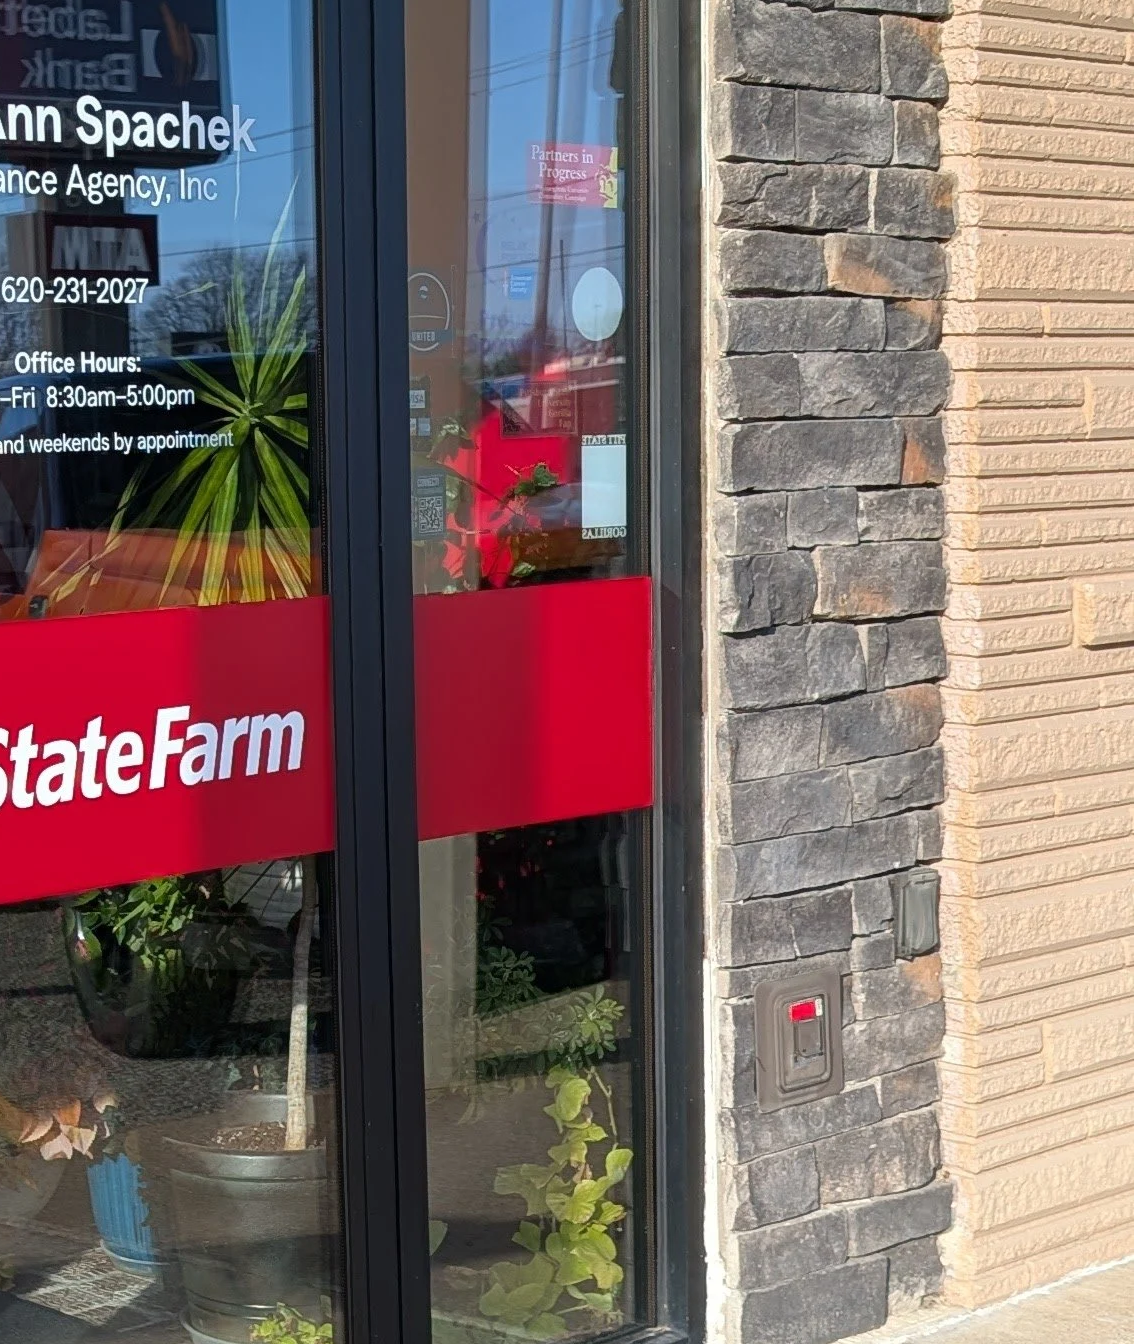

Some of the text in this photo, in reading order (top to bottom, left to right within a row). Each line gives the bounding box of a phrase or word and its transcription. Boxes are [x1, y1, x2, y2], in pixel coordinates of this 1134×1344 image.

[76, 95, 257, 158] Spachek
[531, 144, 594, 164] Partners in
[539, 162, 587, 182] Progress
[65, 164, 171, 207] Agency,
[180, 168, 218, 201] Inc
[1, 276, 149, 304] 620-231-2027
[14, 350, 141, 374] Office Hours:
[28, 432, 110, 453] weekends
[114, 432, 133, 455] by
[137, 430, 233, 454] appointment
